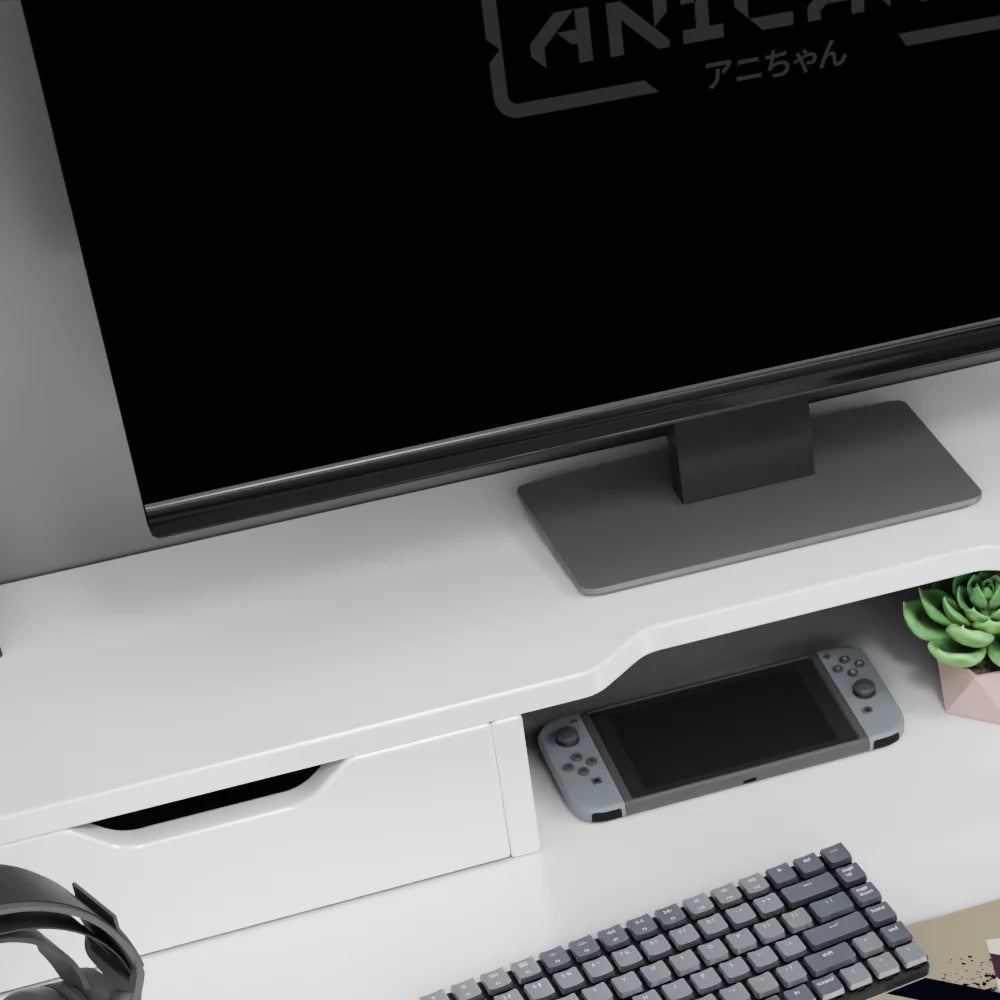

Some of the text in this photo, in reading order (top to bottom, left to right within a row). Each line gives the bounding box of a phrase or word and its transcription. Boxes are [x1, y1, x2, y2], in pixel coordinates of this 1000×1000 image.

[705, 40, 848, 90] アニちゃん
